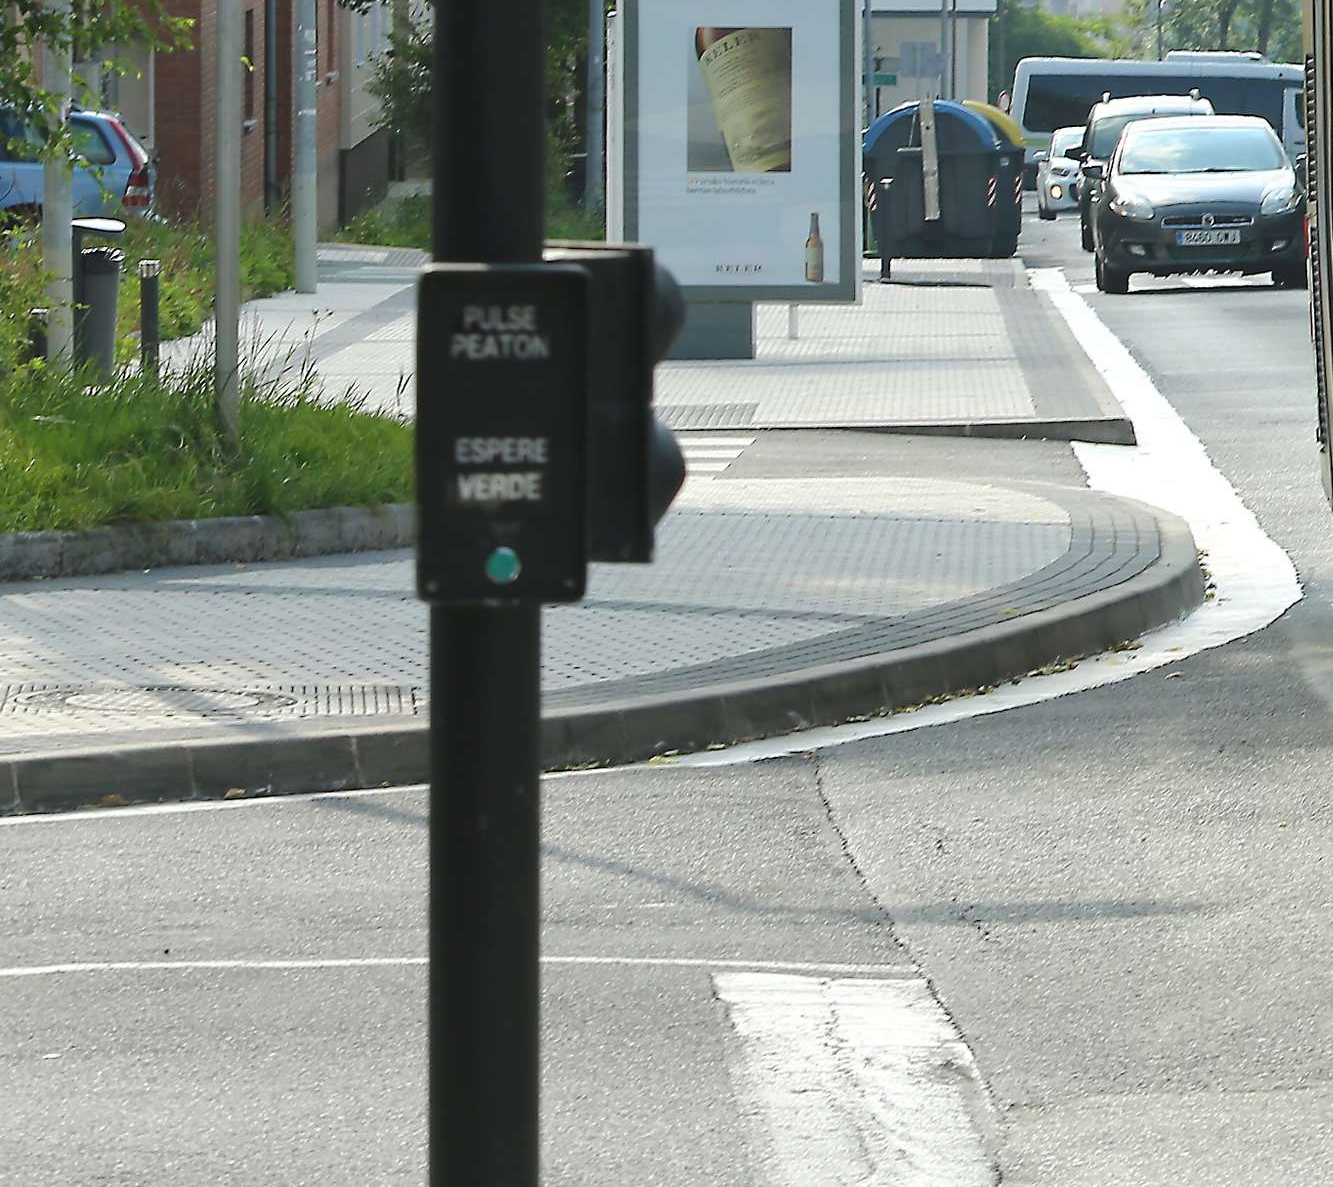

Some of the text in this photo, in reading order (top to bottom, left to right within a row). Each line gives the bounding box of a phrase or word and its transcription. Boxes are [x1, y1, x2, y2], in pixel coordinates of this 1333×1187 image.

[463, 306, 536, 330] PULSE
[451, 334, 550, 358] PEATON
[456, 437, 548, 464] ESPERE
[457, 474, 541, 500] VERDE
